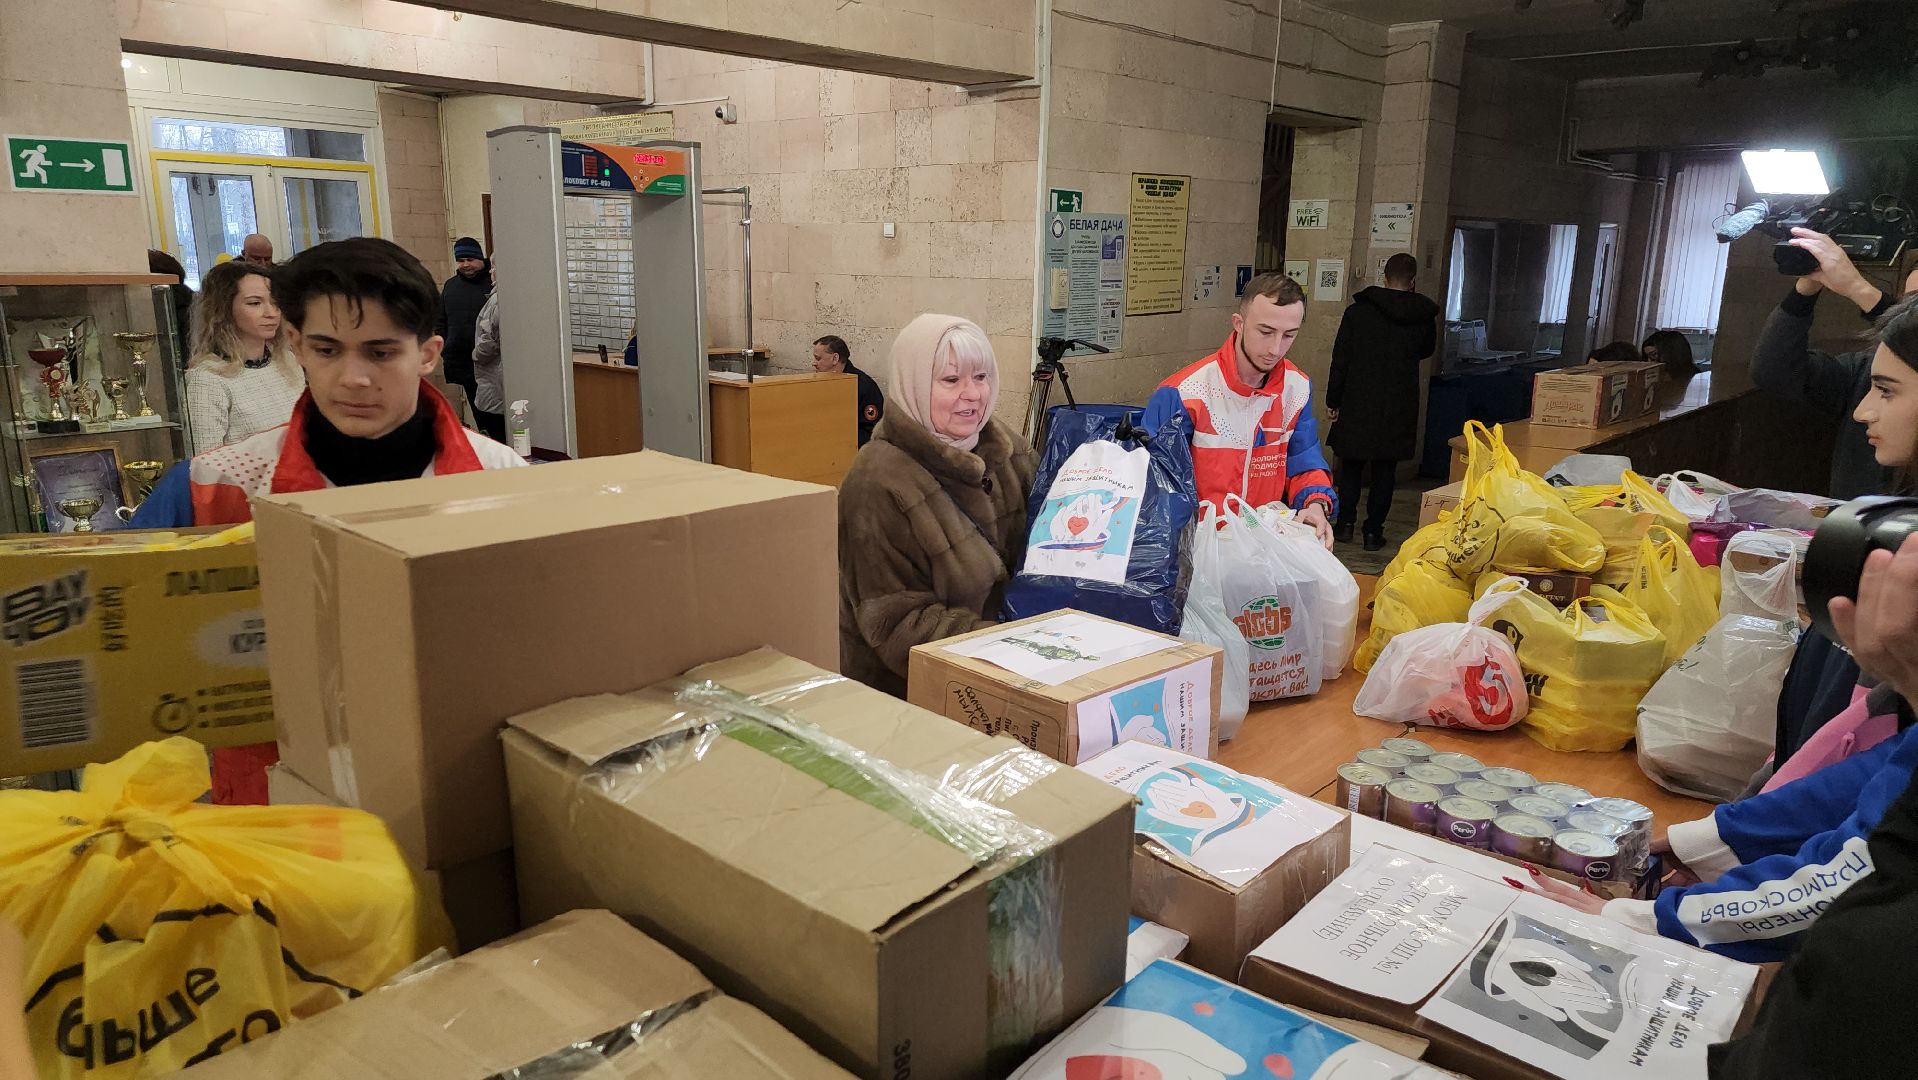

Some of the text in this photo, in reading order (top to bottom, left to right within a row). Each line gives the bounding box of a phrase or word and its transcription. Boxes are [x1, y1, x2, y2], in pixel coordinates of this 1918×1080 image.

[1069, 218, 1124, 233] БЕЛАЯ ДАЧА
[1249, 658, 1278, 673] десь
[1250, 685, 1286, 701] округ
[1668, 984, 1713, 1049] ДОБРОЕ ДЕЛО
